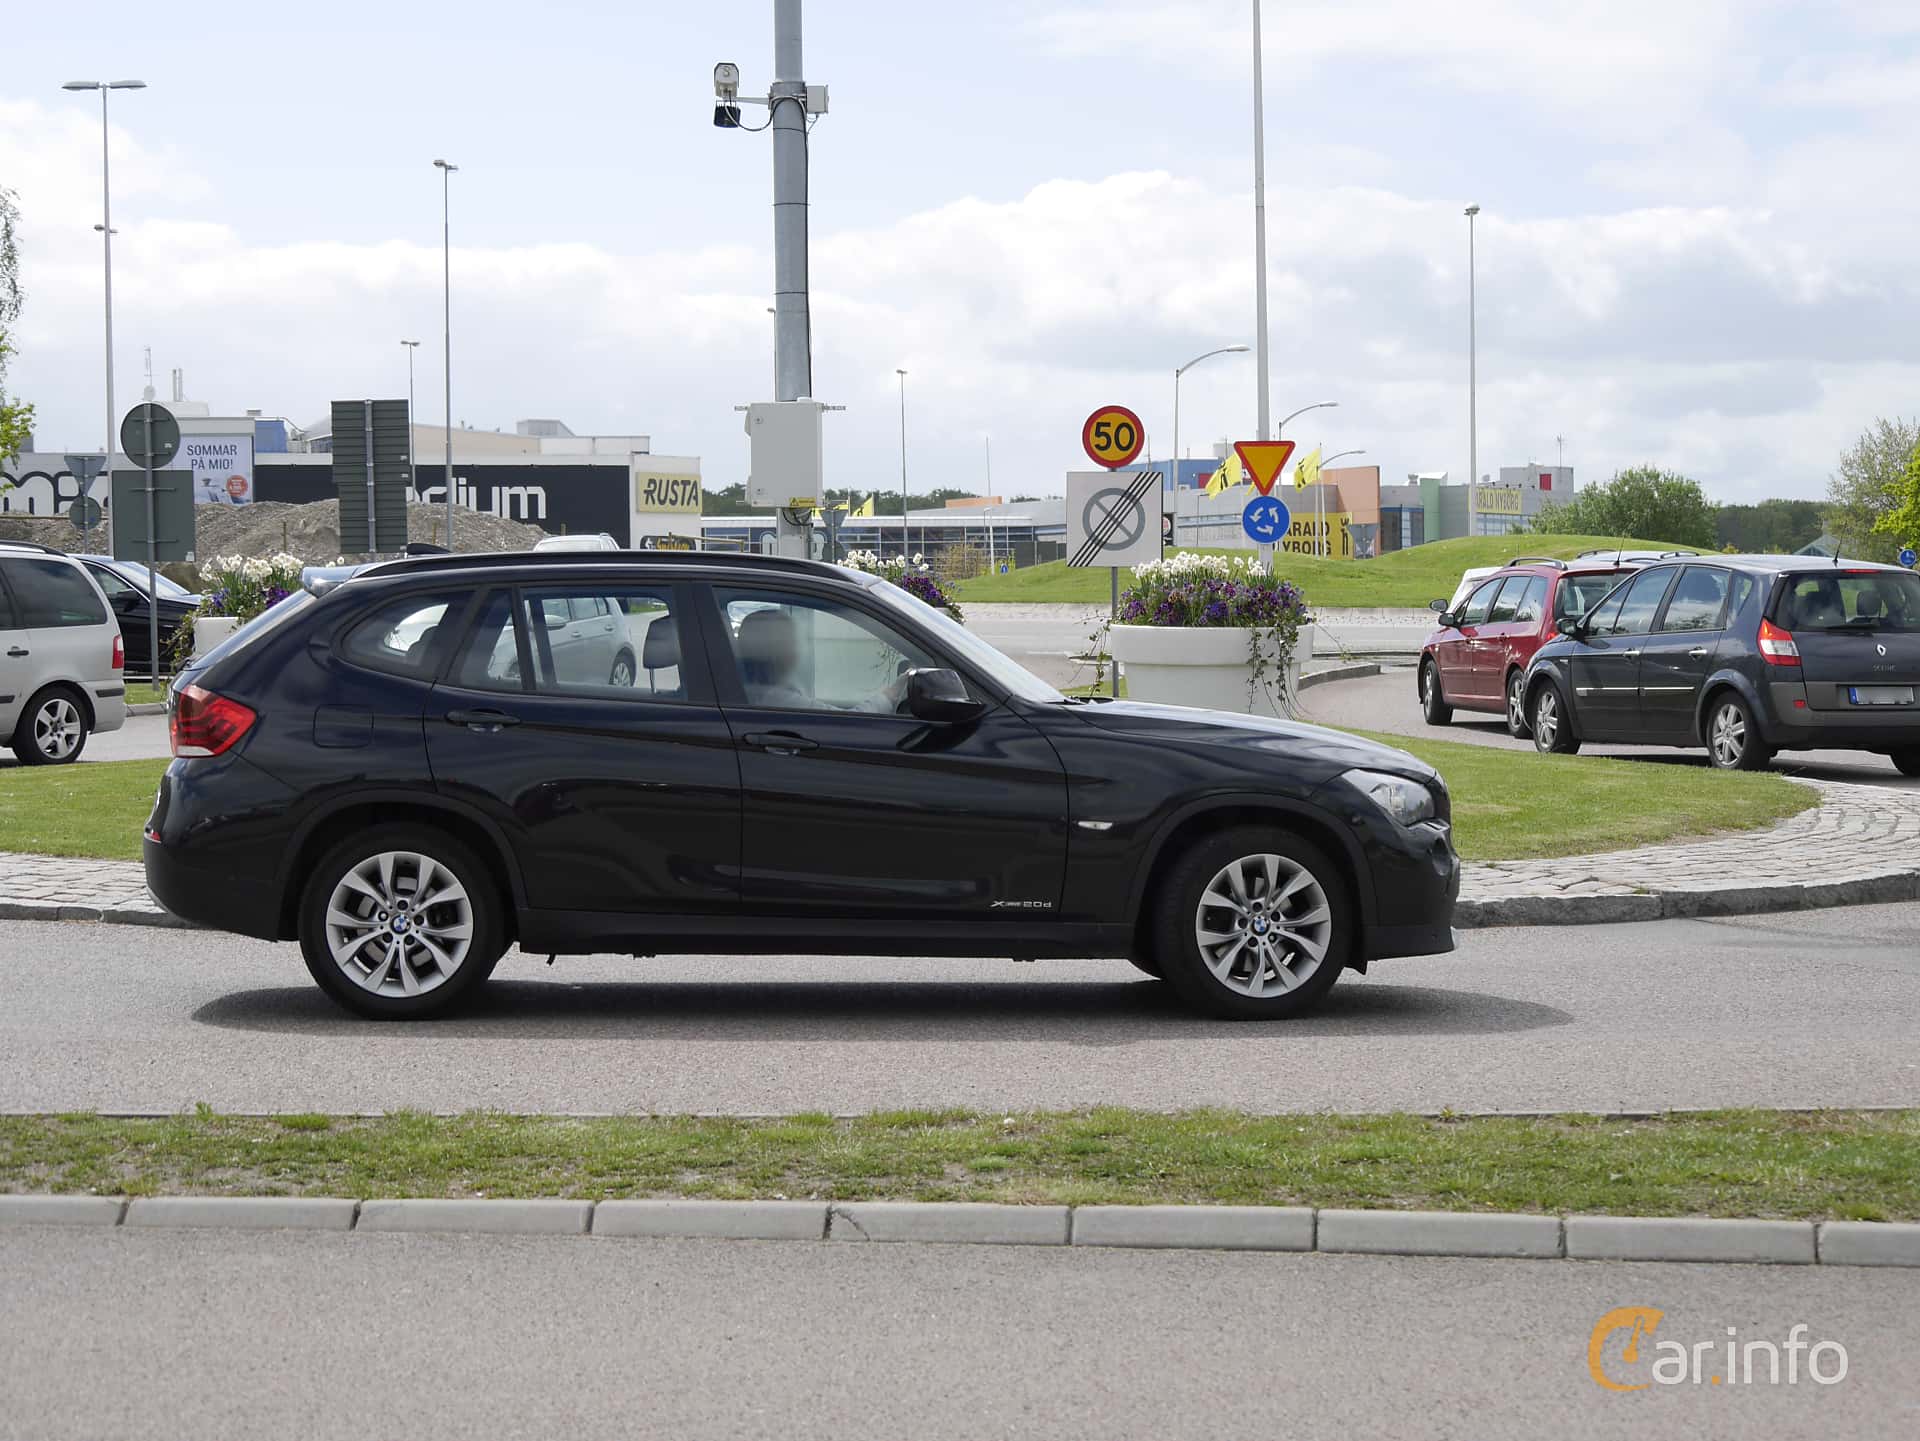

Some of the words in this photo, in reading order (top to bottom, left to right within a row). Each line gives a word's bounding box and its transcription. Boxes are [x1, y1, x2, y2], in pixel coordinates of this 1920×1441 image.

[1094, 421, 1135, 452] 50
[186, 444, 238, 456] SOMMAR
[191, 457, 206, 470] PÅ
[208, 458, 233, 470] MIO!
[643, 478, 699, 507] RUSTA
